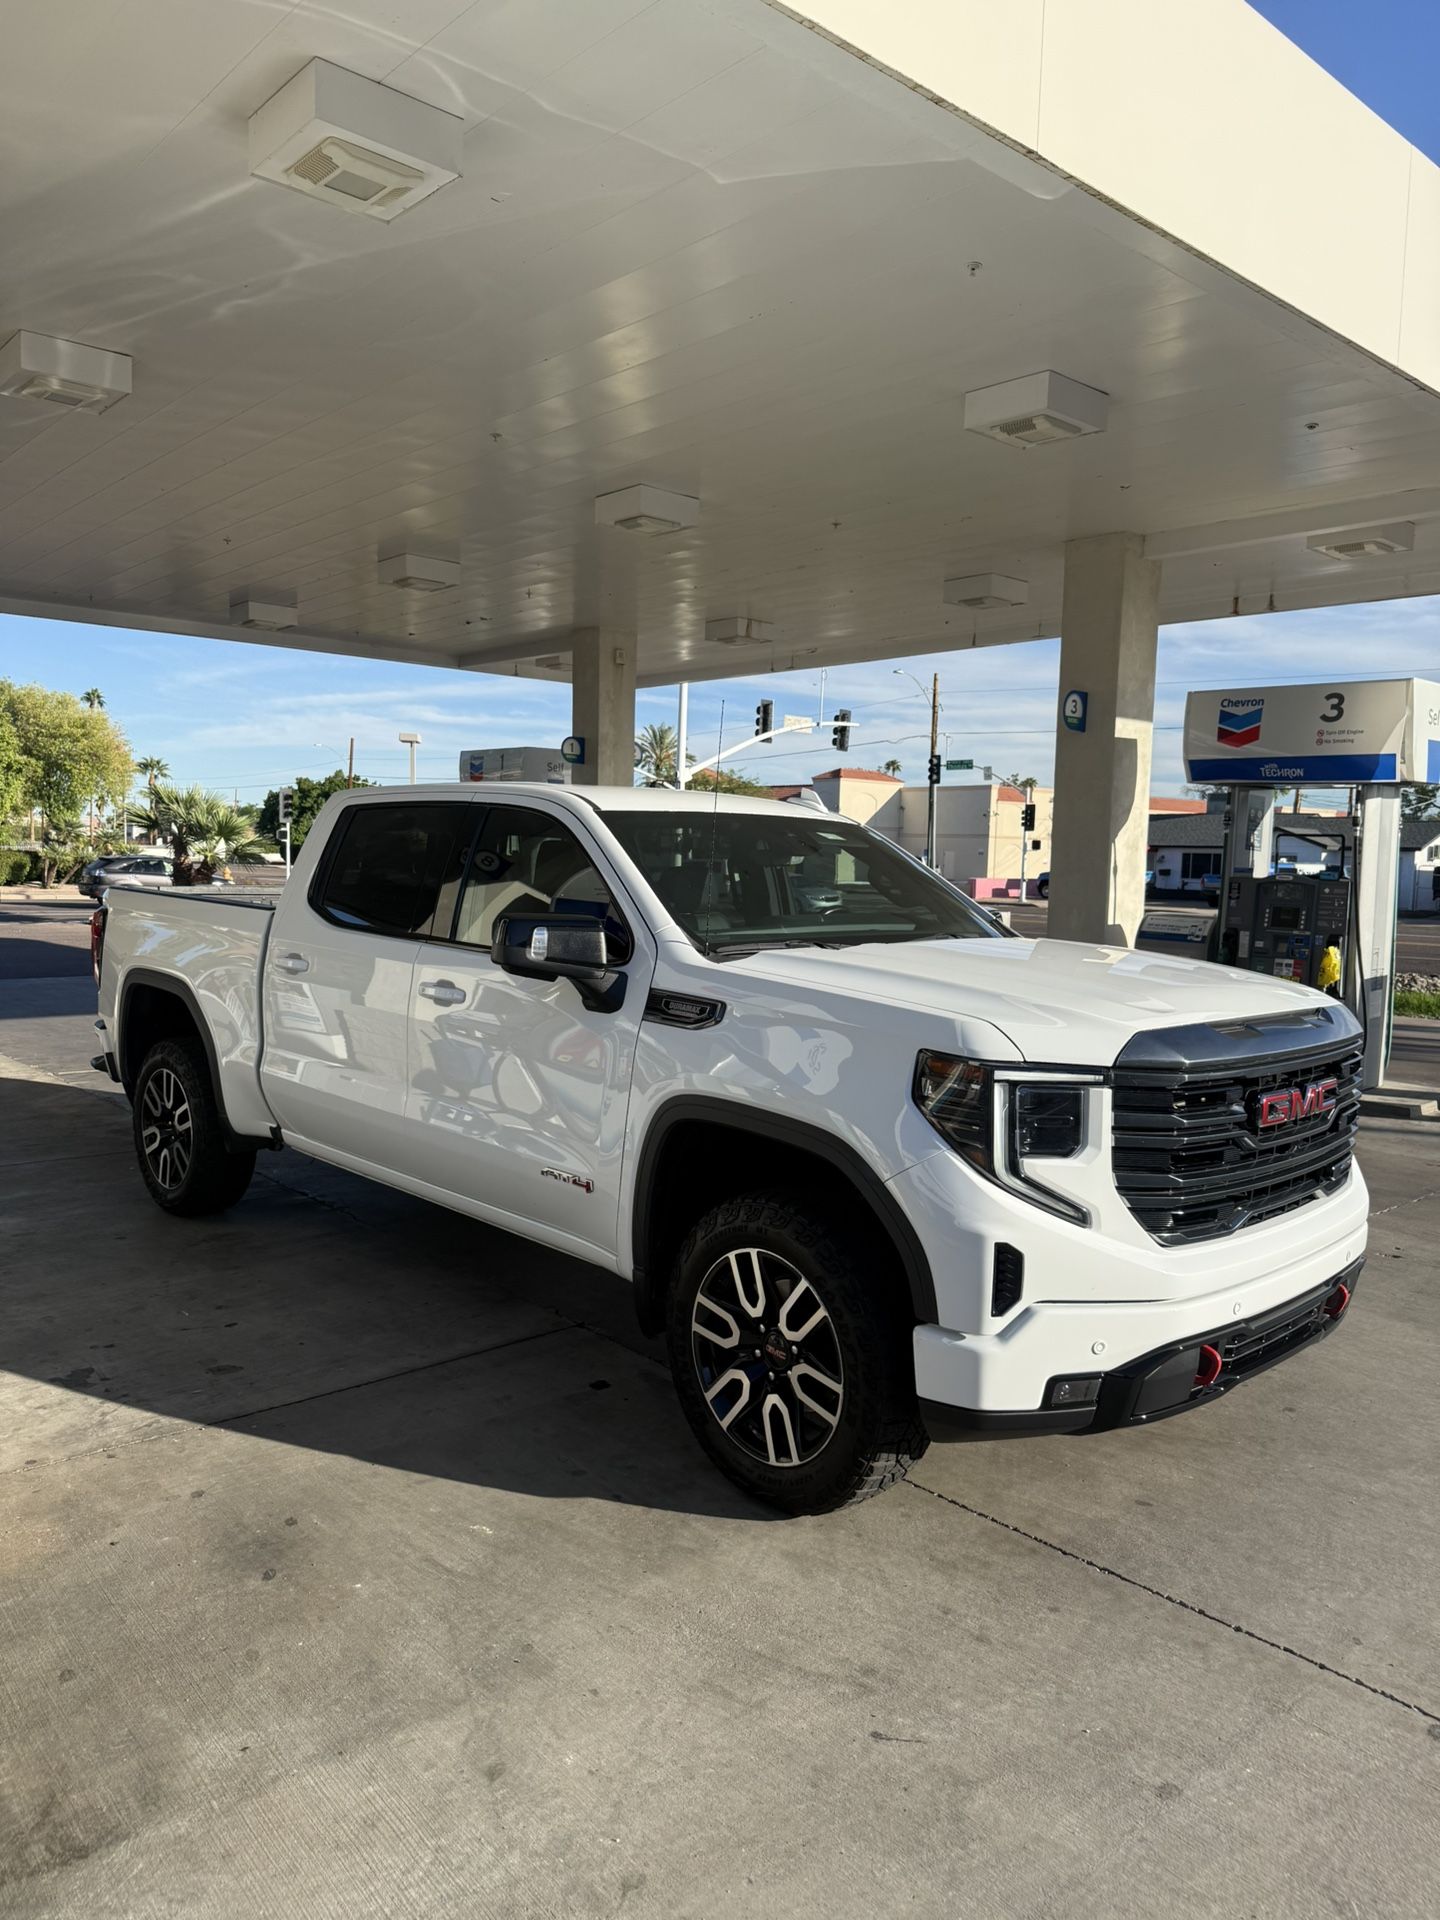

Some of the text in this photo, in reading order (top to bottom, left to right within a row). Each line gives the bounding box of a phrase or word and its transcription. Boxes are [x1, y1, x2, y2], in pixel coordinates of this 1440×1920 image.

[1070, 699, 1077, 714] 3
[1220, 698, 1265, 708] Chevron
[1319, 692, 1345, 723] 3
[569, 742, 575, 753] 1
[500, 753, 505, 770] 1
[1259, 767, 1304, 779] TECHRON
[1258, 1078, 1338, 1128] GMC
[766, 1344, 787, 1360] GMC
